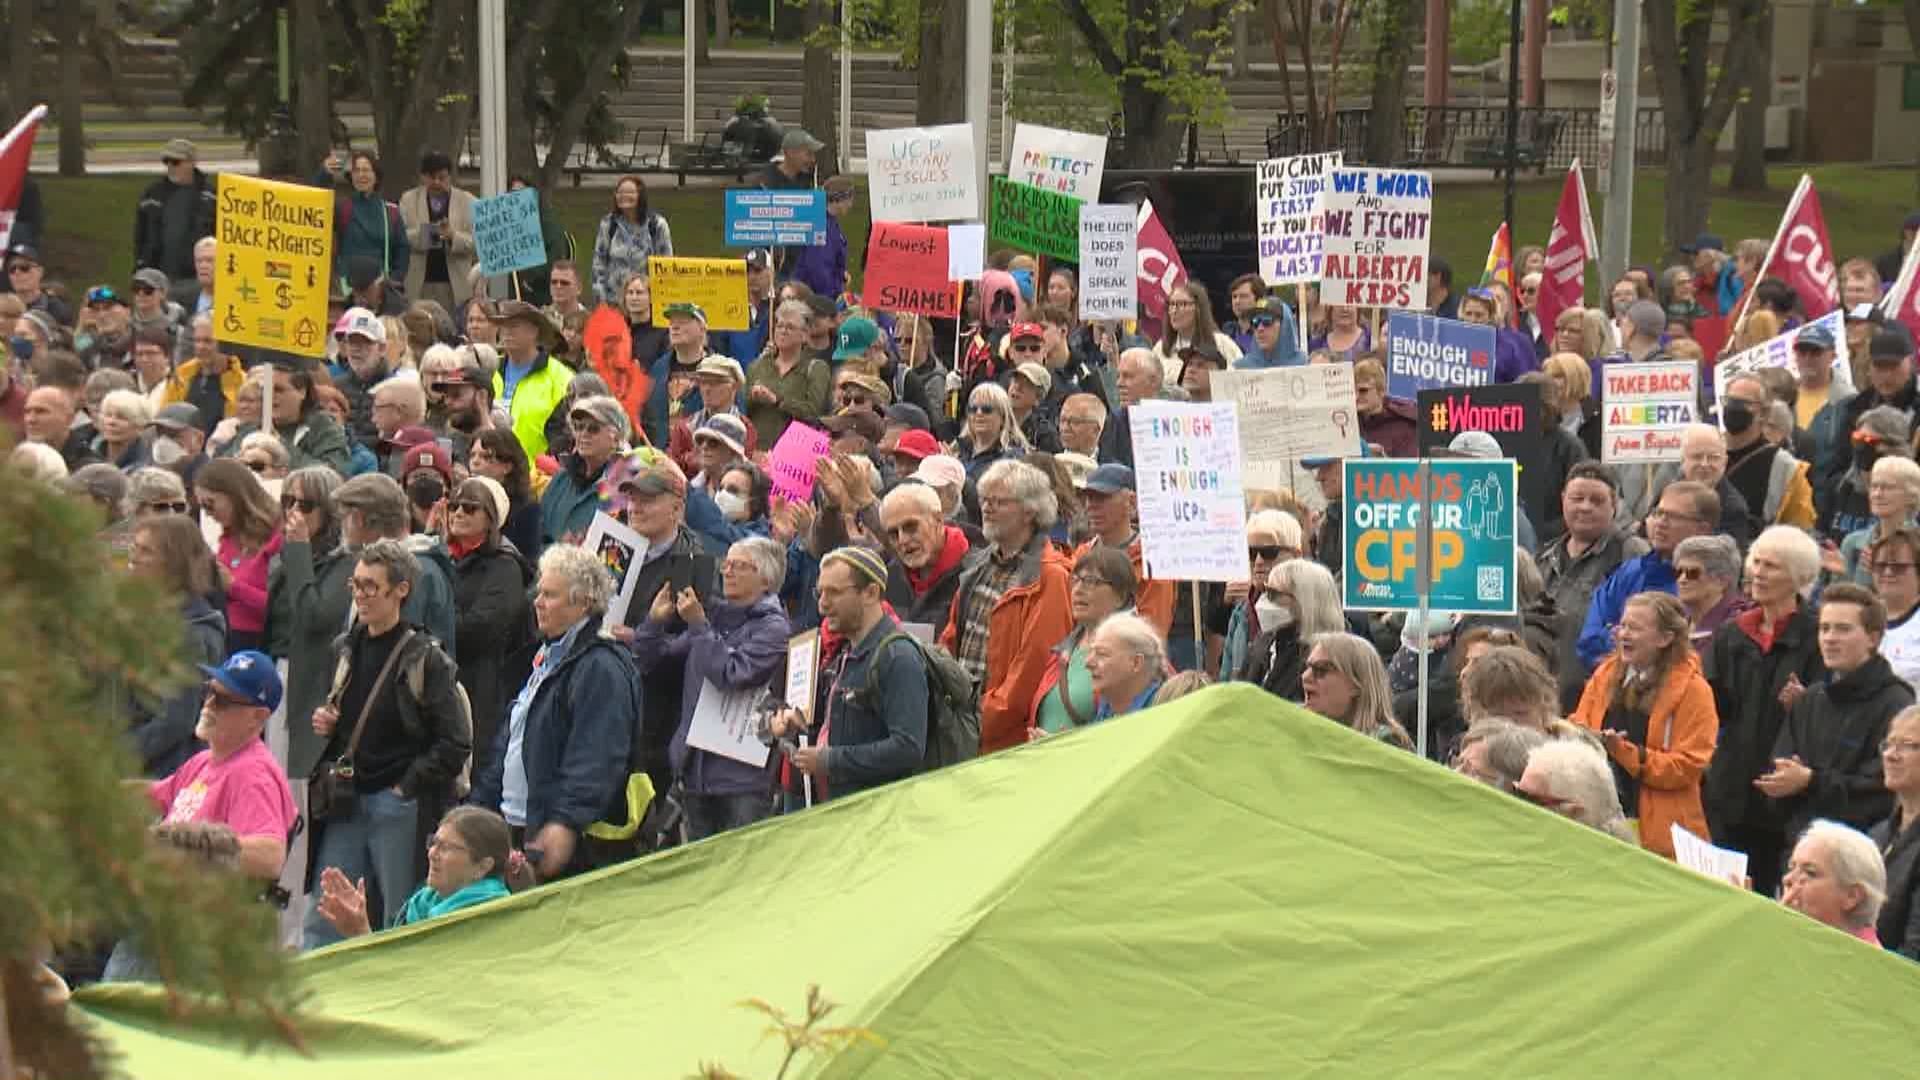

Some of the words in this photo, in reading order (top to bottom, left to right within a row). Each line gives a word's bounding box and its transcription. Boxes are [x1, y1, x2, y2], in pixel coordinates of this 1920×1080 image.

[1023, 150, 1093, 176] PROTECT
[1259, 162, 1285, 180] YOU
[1288, 154, 1340, 178] CAN'T
[1259, 182, 1284, 199] PUT
[1332, 171, 1368, 194] WE
[1270, 197, 1314, 218] FIRST
[1356, 194, 1382, 210] AND
[1083, 221, 1105, 233] THE
[1107, 221, 1133, 233] UCP
[1261, 222, 1277, 235] IF
[1283, 217, 1307, 234] YOU
[1325, 208, 1353, 238] WE
[1364, 211, 1429, 240] FIGHT
[1091, 240, 1124, 252] DOES
[1354, 239, 1385, 255] FOR
[1095, 257, 1120, 268] NOT
[1275, 254, 1323, 277] LAST
[1325, 254, 1422, 283] ALBERTA
[1088, 277, 1128, 289] SPEAK
[1346, 281, 1411, 307] KIDS
[1086, 298, 1109, 311] FOR
[1111, 297, 1130, 310] ME
[1392, 336, 1467, 366] ENOUGH
[1472, 350, 1488, 368] IS
[1392, 354, 1488, 387] ENOUGH!
[1608, 375, 1646, 395] TAKE
[1649, 373, 1691, 392] BACK
[1431, 394, 1524, 432] #Women
[1609, 404, 1691, 426] ALBERTA
[1152, 416, 1213, 438] ENOUGH
[1176, 447, 1189, 466] IS
[1160, 471, 1219, 492] ENOUGH
[1355, 472, 1462, 502] HANDS
[1355, 503, 1402, 528] OFF
[1355, 529, 1465, 582] CPP
